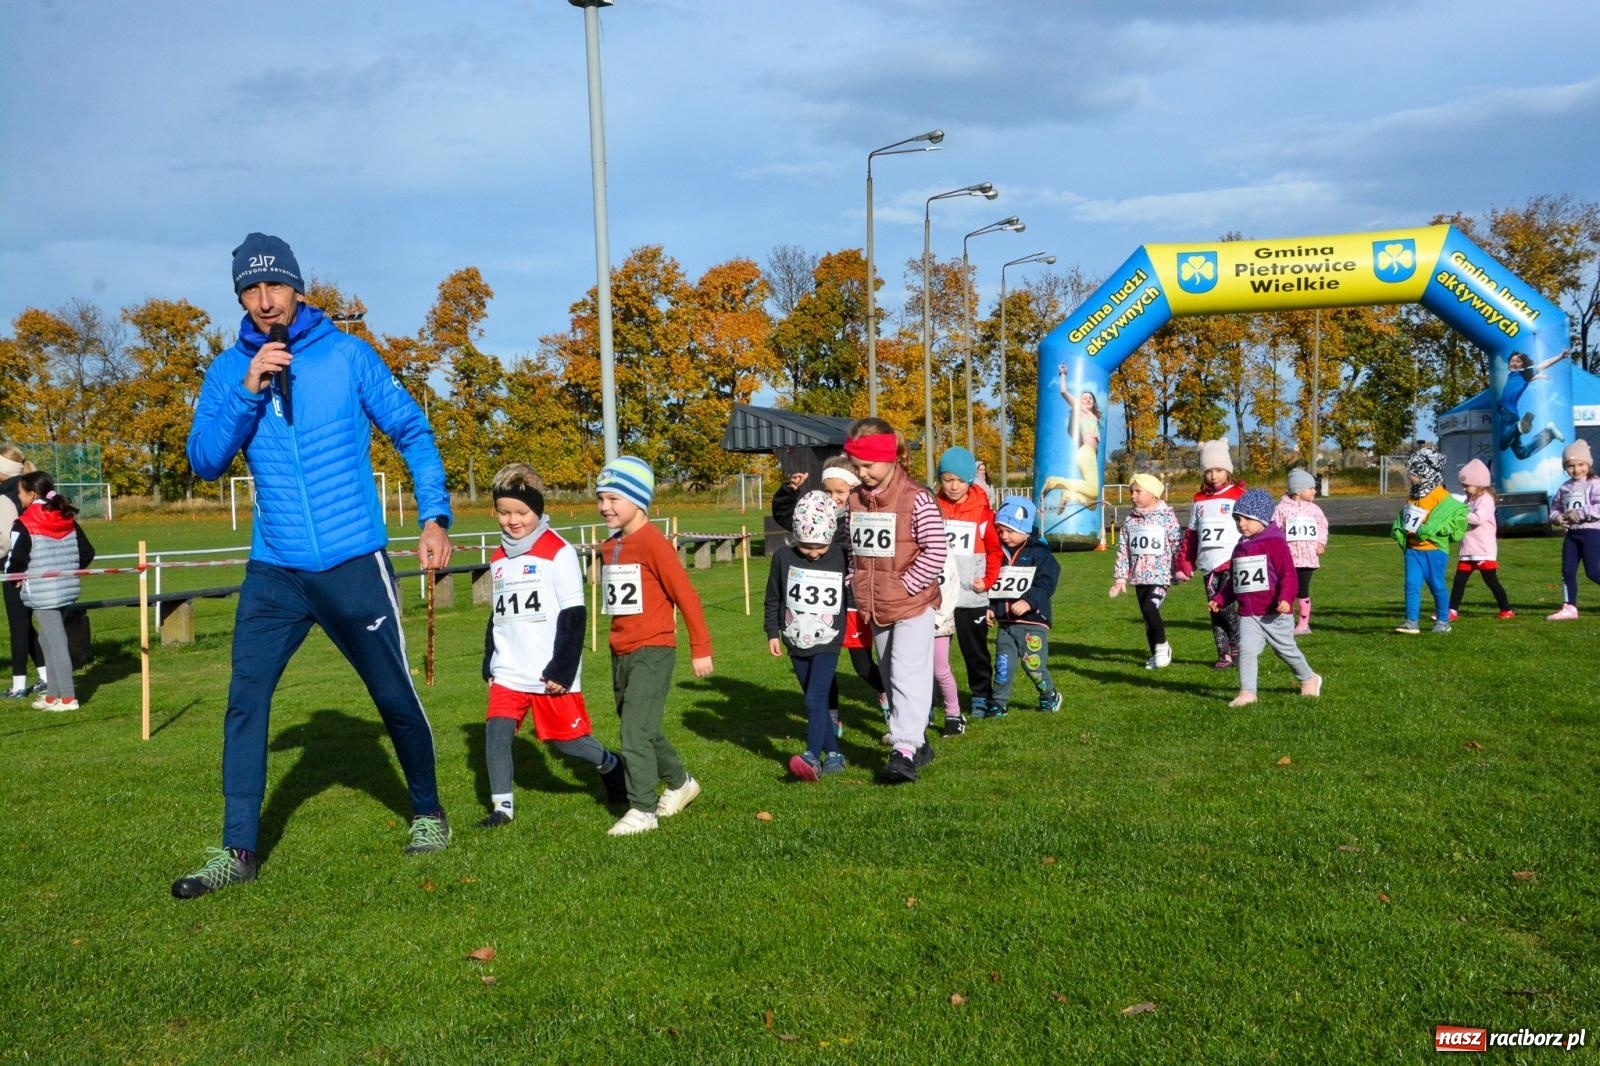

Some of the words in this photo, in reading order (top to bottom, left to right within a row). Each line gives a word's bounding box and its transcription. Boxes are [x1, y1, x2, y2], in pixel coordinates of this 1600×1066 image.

[1255, 246, 1334, 259] Gmina
[1235, 258, 1357, 277] Pietrowice
[1250, 276, 1340, 293] Wielkie
[1450, 251, 1498, 292] Gmina
[1499, 287, 1540, 323] ludzi
[1068, 303, 1114, 343] Gmina
[1109, 268, 1149, 306] ludzi
[1436, 271, 1520, 338] aktywnych
[1086, 287, 1161, 356] aktywnych
[852, 528, 891, 549] 426
[1202, 528, 1225, 542] 27
[1288, 525, 1317, 537] 403
[1130, 535, 1161, 550] 408
[992, 577, 1029, 592] 520
[495, 590, 541, 616] 414
[788, 583, 838, 607] 433
